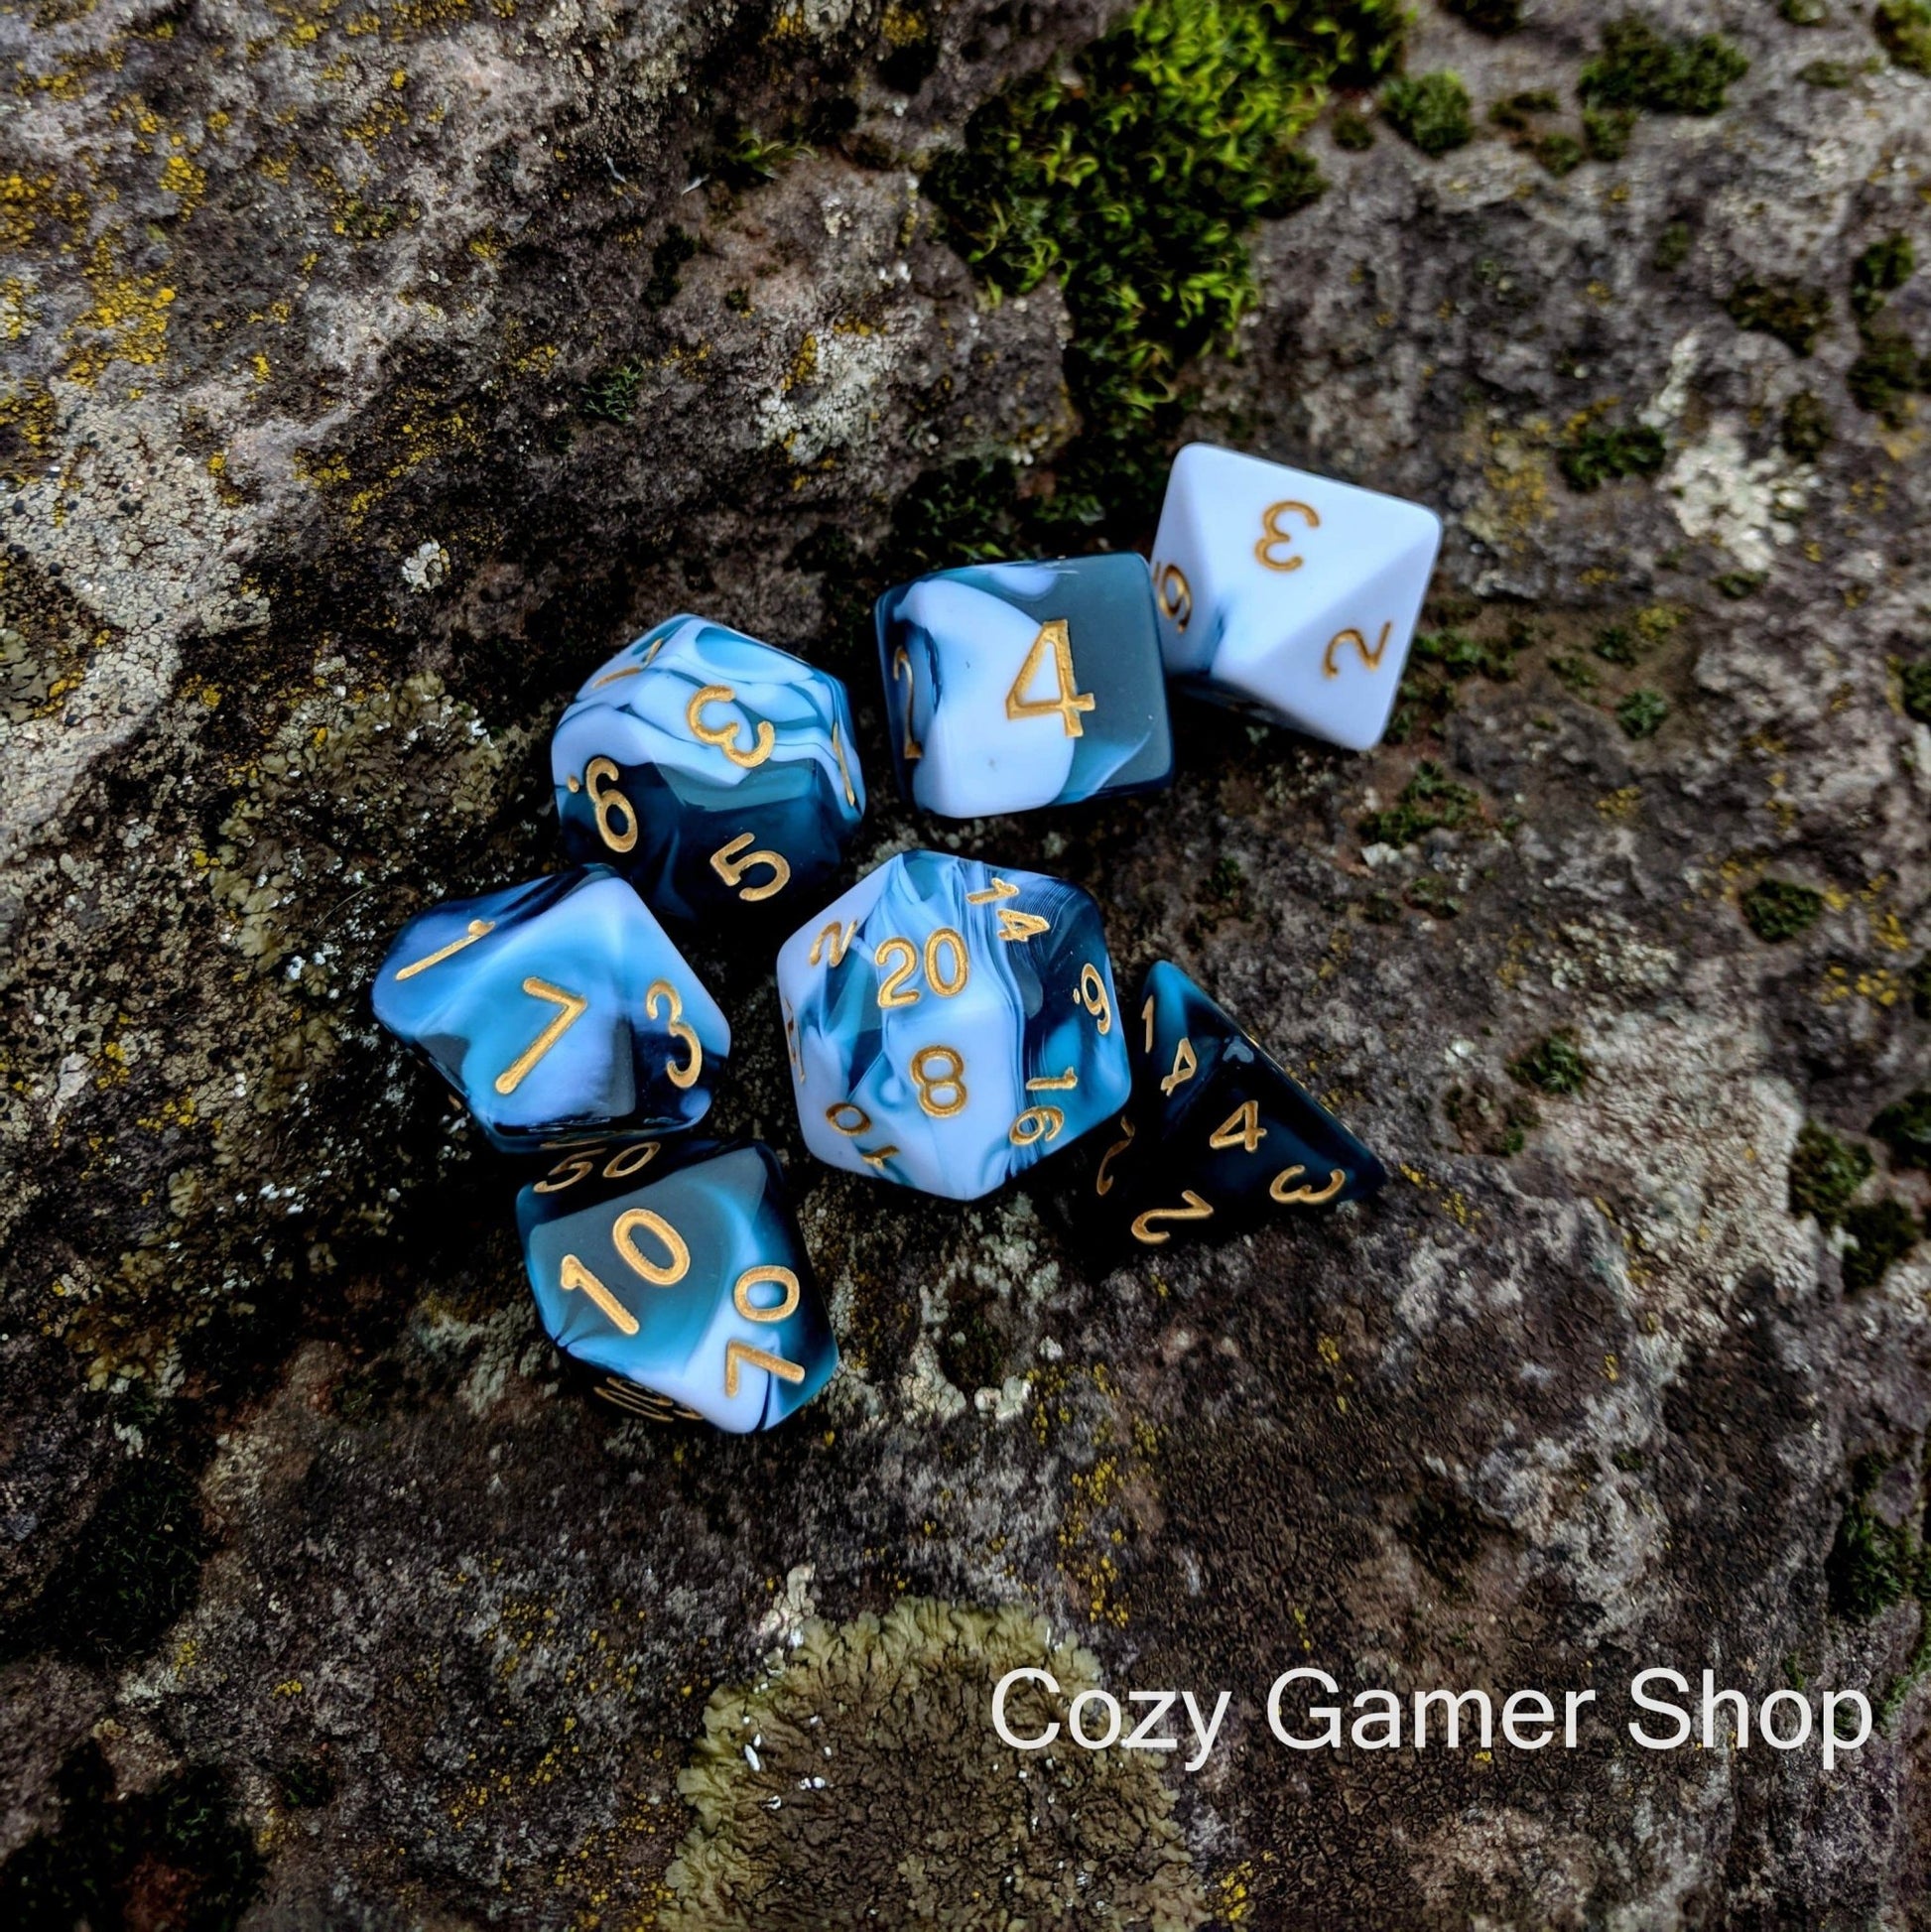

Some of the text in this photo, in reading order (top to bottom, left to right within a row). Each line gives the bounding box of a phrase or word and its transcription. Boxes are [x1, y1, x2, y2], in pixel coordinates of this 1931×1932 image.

[1253, 499, 1322, 573] 3
[1005, 618, 1095, 738] 4
[685, 684, 777, 769] 3
[708, 832, 792, 902] 5
[874, 926, 970, 1009] 20
[494, 975, 588, 1095] 7
[645, 977, 704, 1090] 3
[909, 1044, 968, 1118] 8
[1209, 1098, 1268, 1153] 4
[532, 1140, 662, 1194] 50
[1269, 1163, 1347, 1205] 3
[559, 1207, 692, 1336] 10
